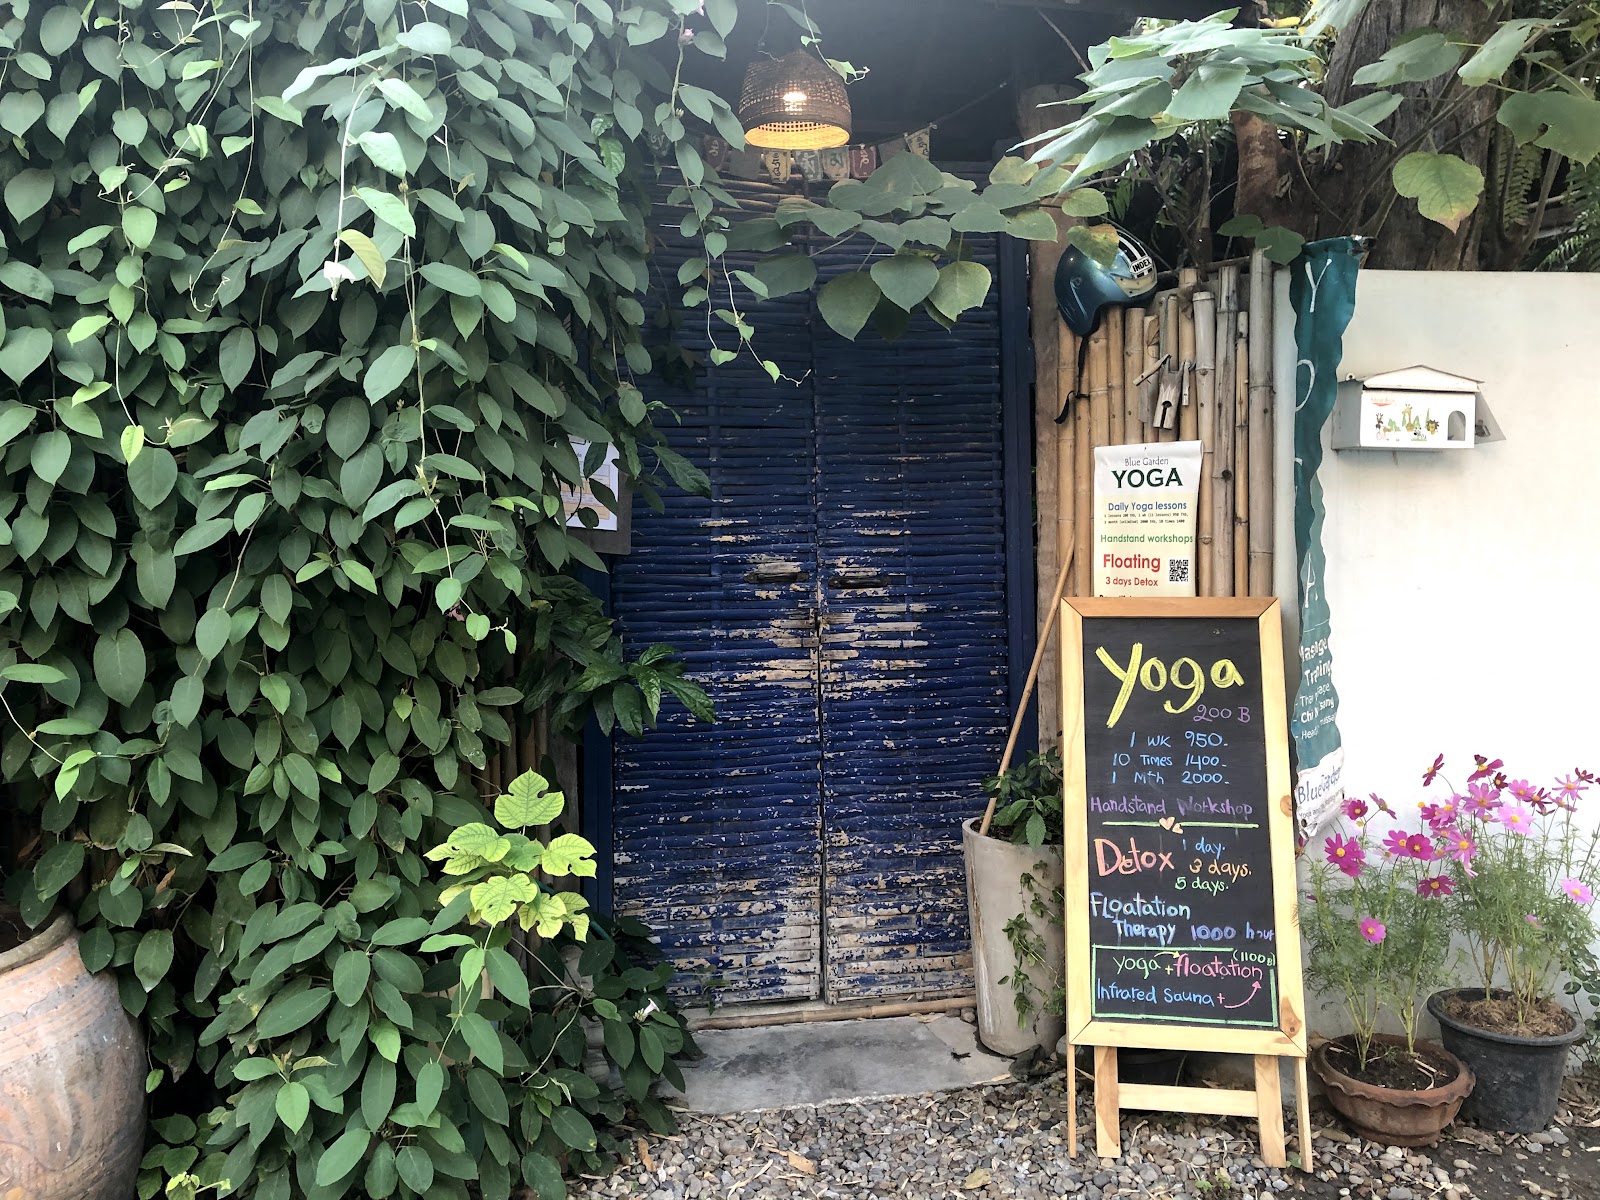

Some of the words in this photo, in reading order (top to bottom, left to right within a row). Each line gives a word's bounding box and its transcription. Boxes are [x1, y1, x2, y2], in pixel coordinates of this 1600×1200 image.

[1132, 258, 1152, 273] INDEX
[1124, 457, 1141, 467] Blue
[1142, 456, 1169, 466] Garden
[1111, 467, 1183, 488] YOGA
[1108, 502, 1129, 512] Daily
[1131, 502, 1153, 512] Yoga
[1155, 501, 1187, 511] lessons
[1100, 534, 1145, 543] Handstand
[1147, 533, 1194, 545] workshops
[1103, 554, 1161, 573] Floating
[1105, 576, 1111, 585] 3
[1112, 576, 1132, 587] days
[1134, 577, 1159, 587] Detox
[1095, 641, 1245, 728] Yoga
[1193, 703, 1232, 723] 200
[1237, 706, 1251, 723] B
[1130, 731, 1136, 748] 1
[1112, 752, 1131, 766] 10
[1140, 754, 1173, 767] Times
[1112, 771, 1117, 784] 1
[1090, 795, 1167, 814] Handstand
[1176, 796, 1253, 820] Workshop
[1182, 838, 1187, 850] 1
[1094, 836, 1175, 877] Detox
[1189, 858, 1203, 873] 3
[1175, 876, 1187, 890] 5
[1112, 918, 1176, 946] Therapy
[1191, 925, 1237, 941] 1000
[1173, 953, 1263, 980] floatation
[1097, 978, 1157, 1004] Infrared
[1163, 988, 1215, 1007] Sauna
